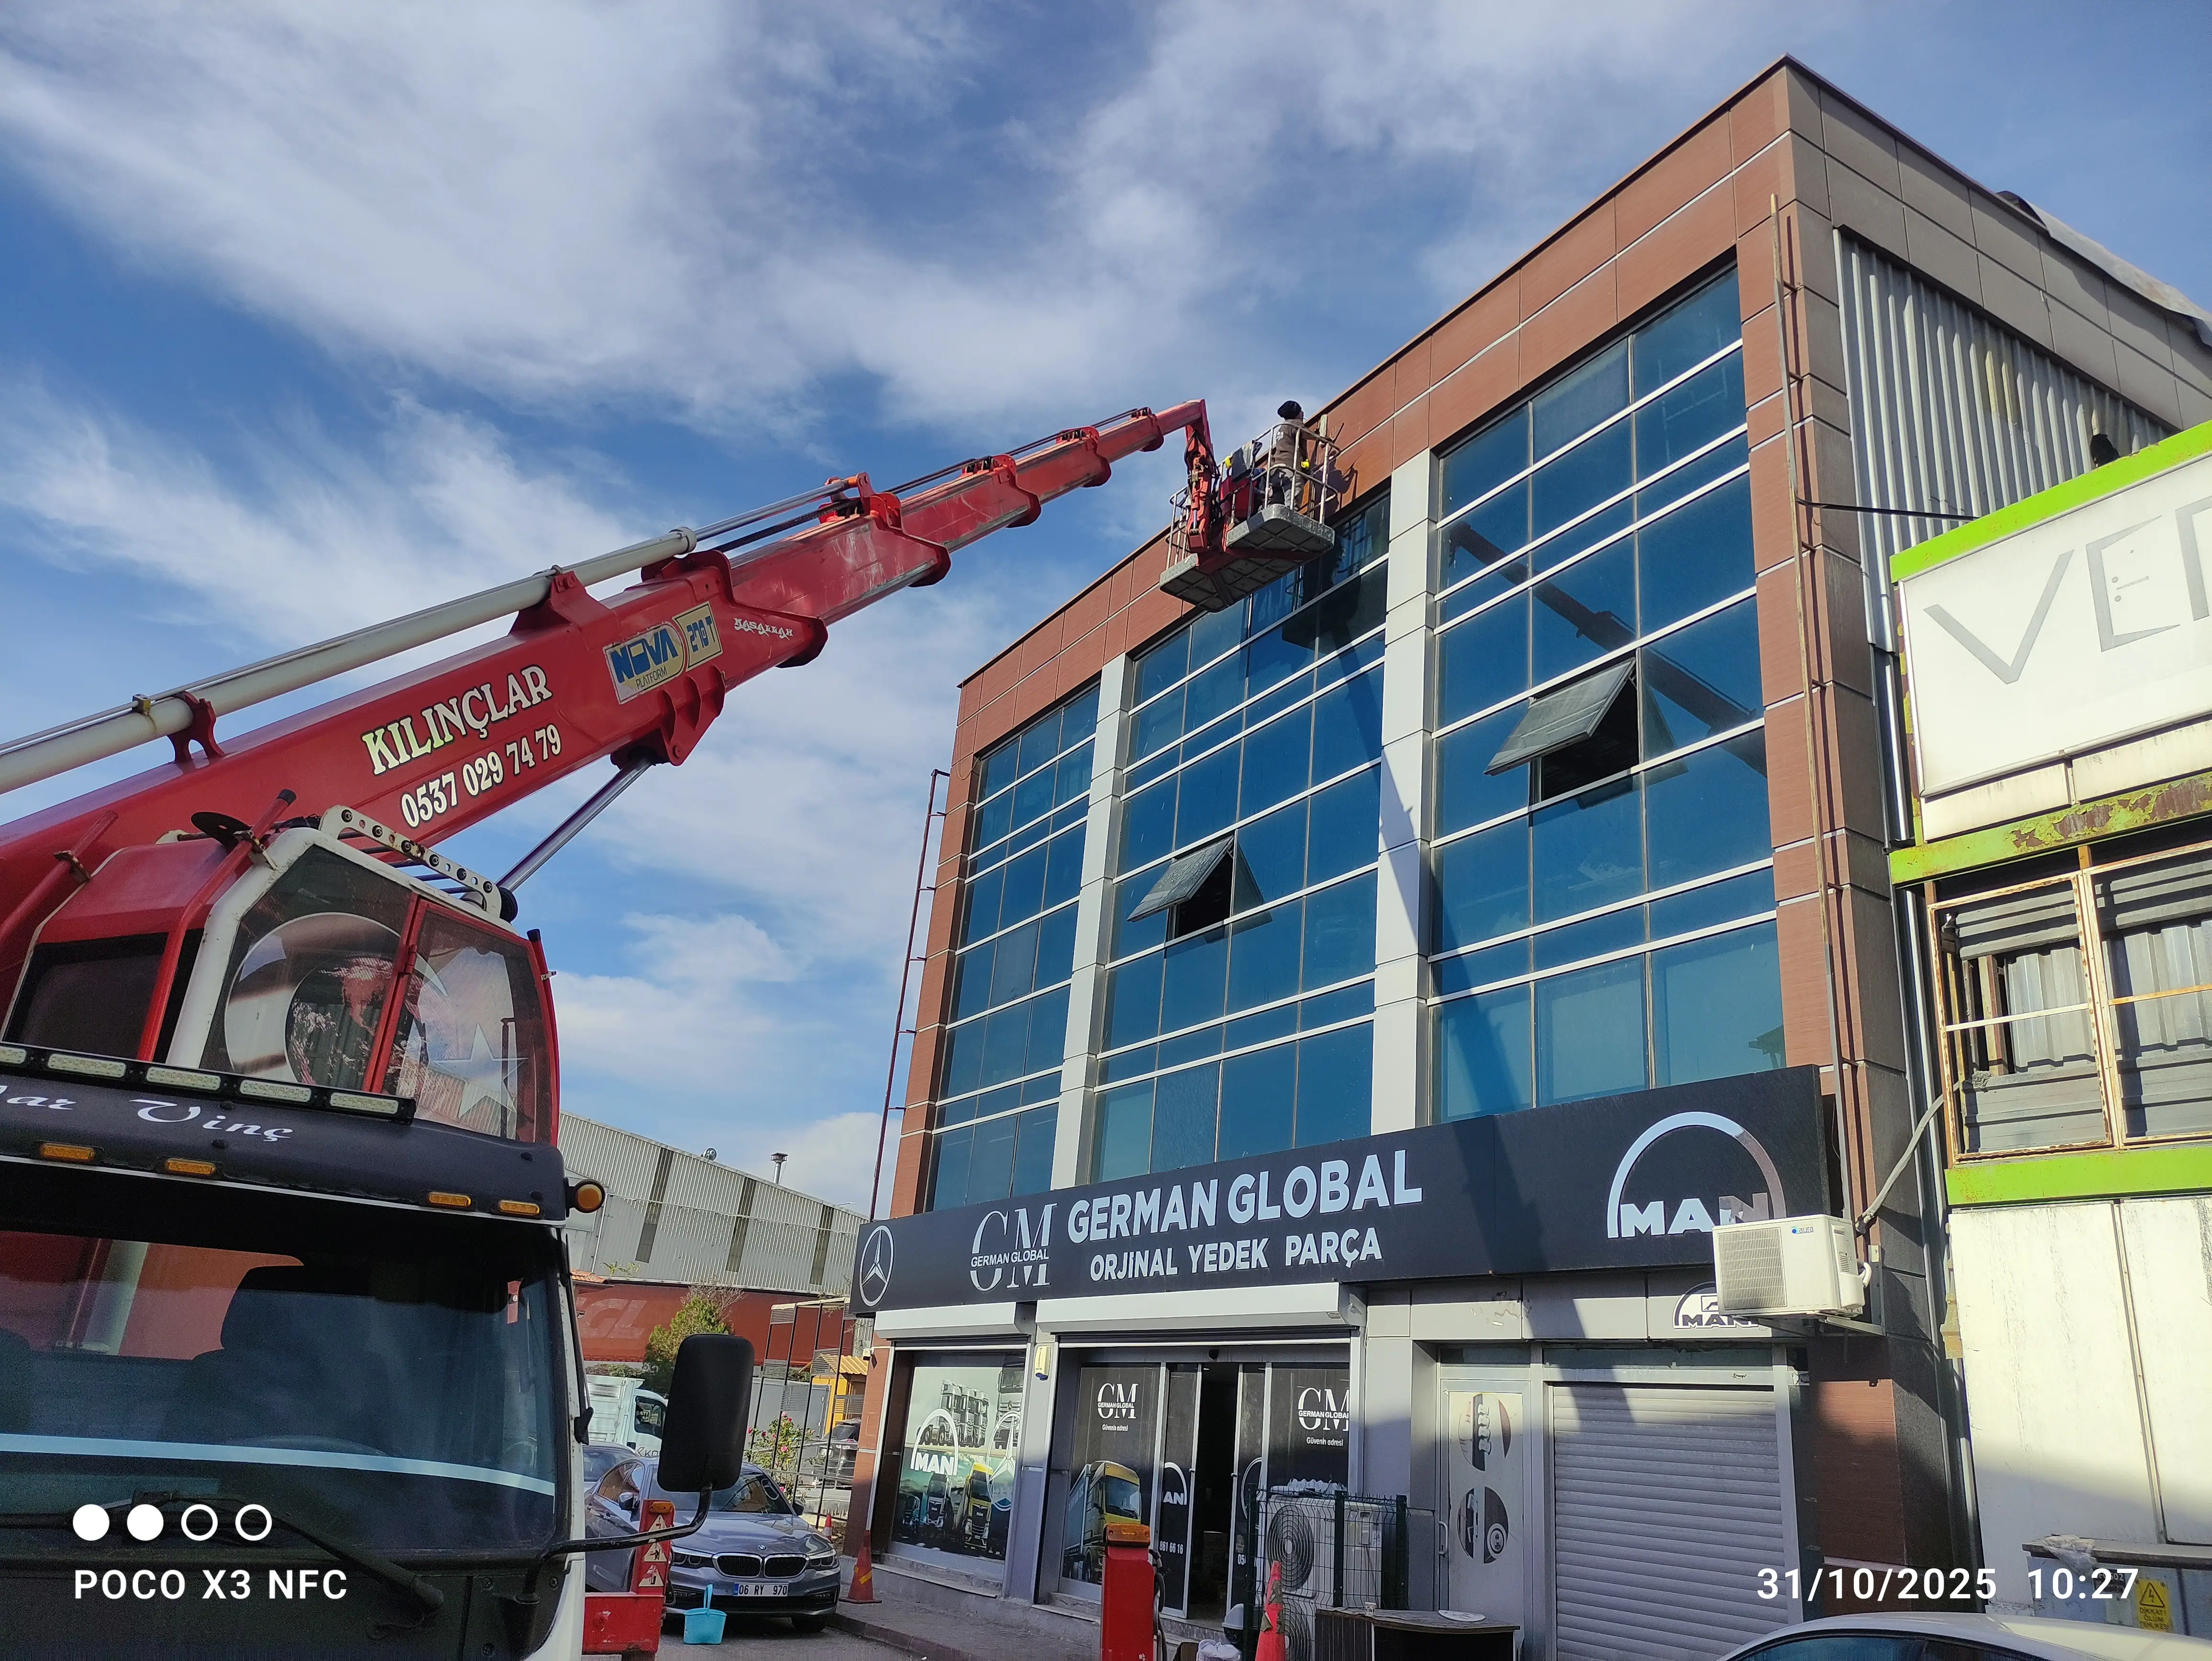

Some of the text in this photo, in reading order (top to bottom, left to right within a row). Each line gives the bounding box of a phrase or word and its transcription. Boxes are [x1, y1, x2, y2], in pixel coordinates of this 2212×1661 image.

[610, 629, 678, 683] NOVA
[636, 667, 667, 689] PLATFORM
[362, 666, 552, 775] KILINÇLAR
[401, 724, 561, 827] 0537 029 74 79
[1068, 1150, 1422, 1244] GERMAN GLOBAL
[1621, 1193, 1769, 1238] MAN
[971, 1249, 1050, 1268] GERMAN GLOBAL
[1188, 1238, 1268, 1273] YEDEK
[1285, 1228, 1382, 1268] PARÇA
[1298, 1410, 1325, 1418] GERMAN
[915, 1452, 954, 1475] MAN
[1162, 1491, 1184, 1506] AN
[1160, 1540, 1183, 1554] 861 66 16
[739, 1585, 787, 1595] 06 RY 970
